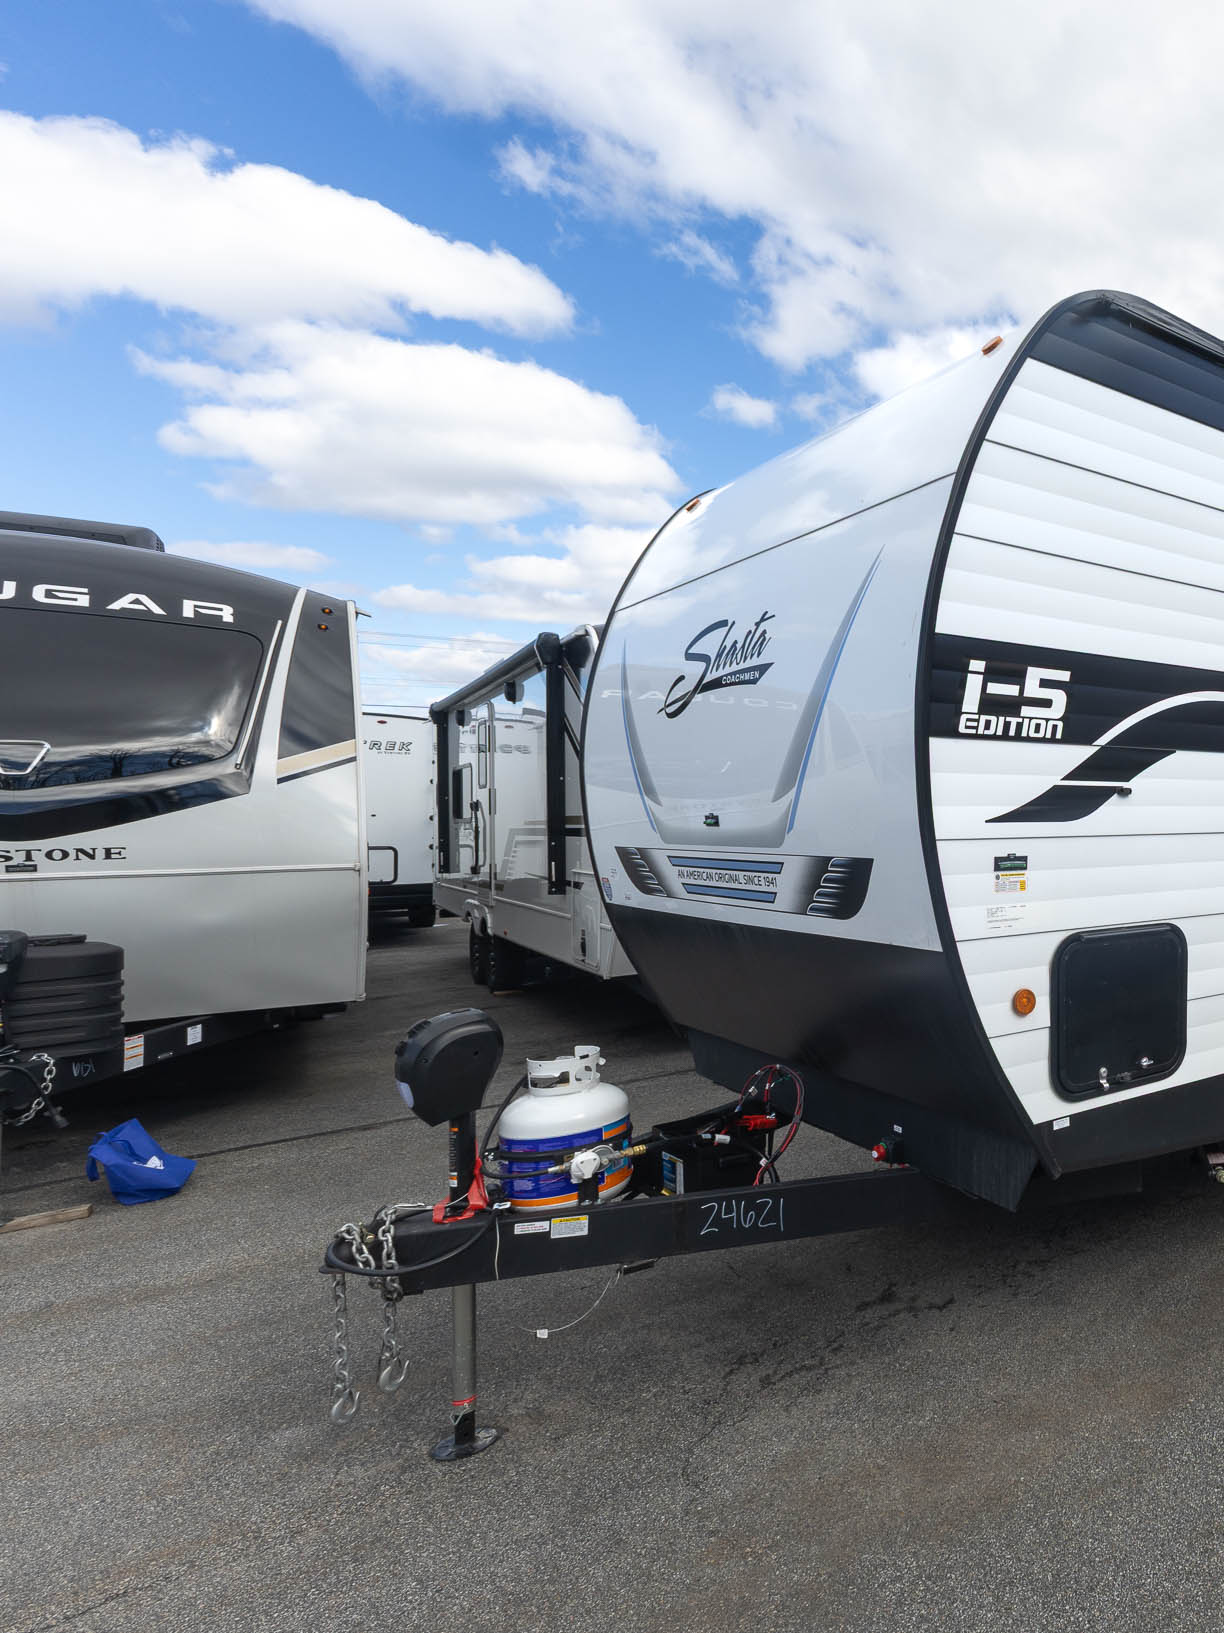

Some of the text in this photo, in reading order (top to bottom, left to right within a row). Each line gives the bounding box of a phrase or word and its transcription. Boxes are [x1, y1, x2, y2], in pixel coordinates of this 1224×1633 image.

[659, 610, 776, 719] Shasta
[721, 670, 760, 685] COACHMEN
[363, 739, 413, 752] REK
[0, 846, 127, 862] STONE
[678, 868, 778, 888] AN AMERICAN ORIGINAL SINCE 1941
[700, 1197, 784, 1236] 24621
